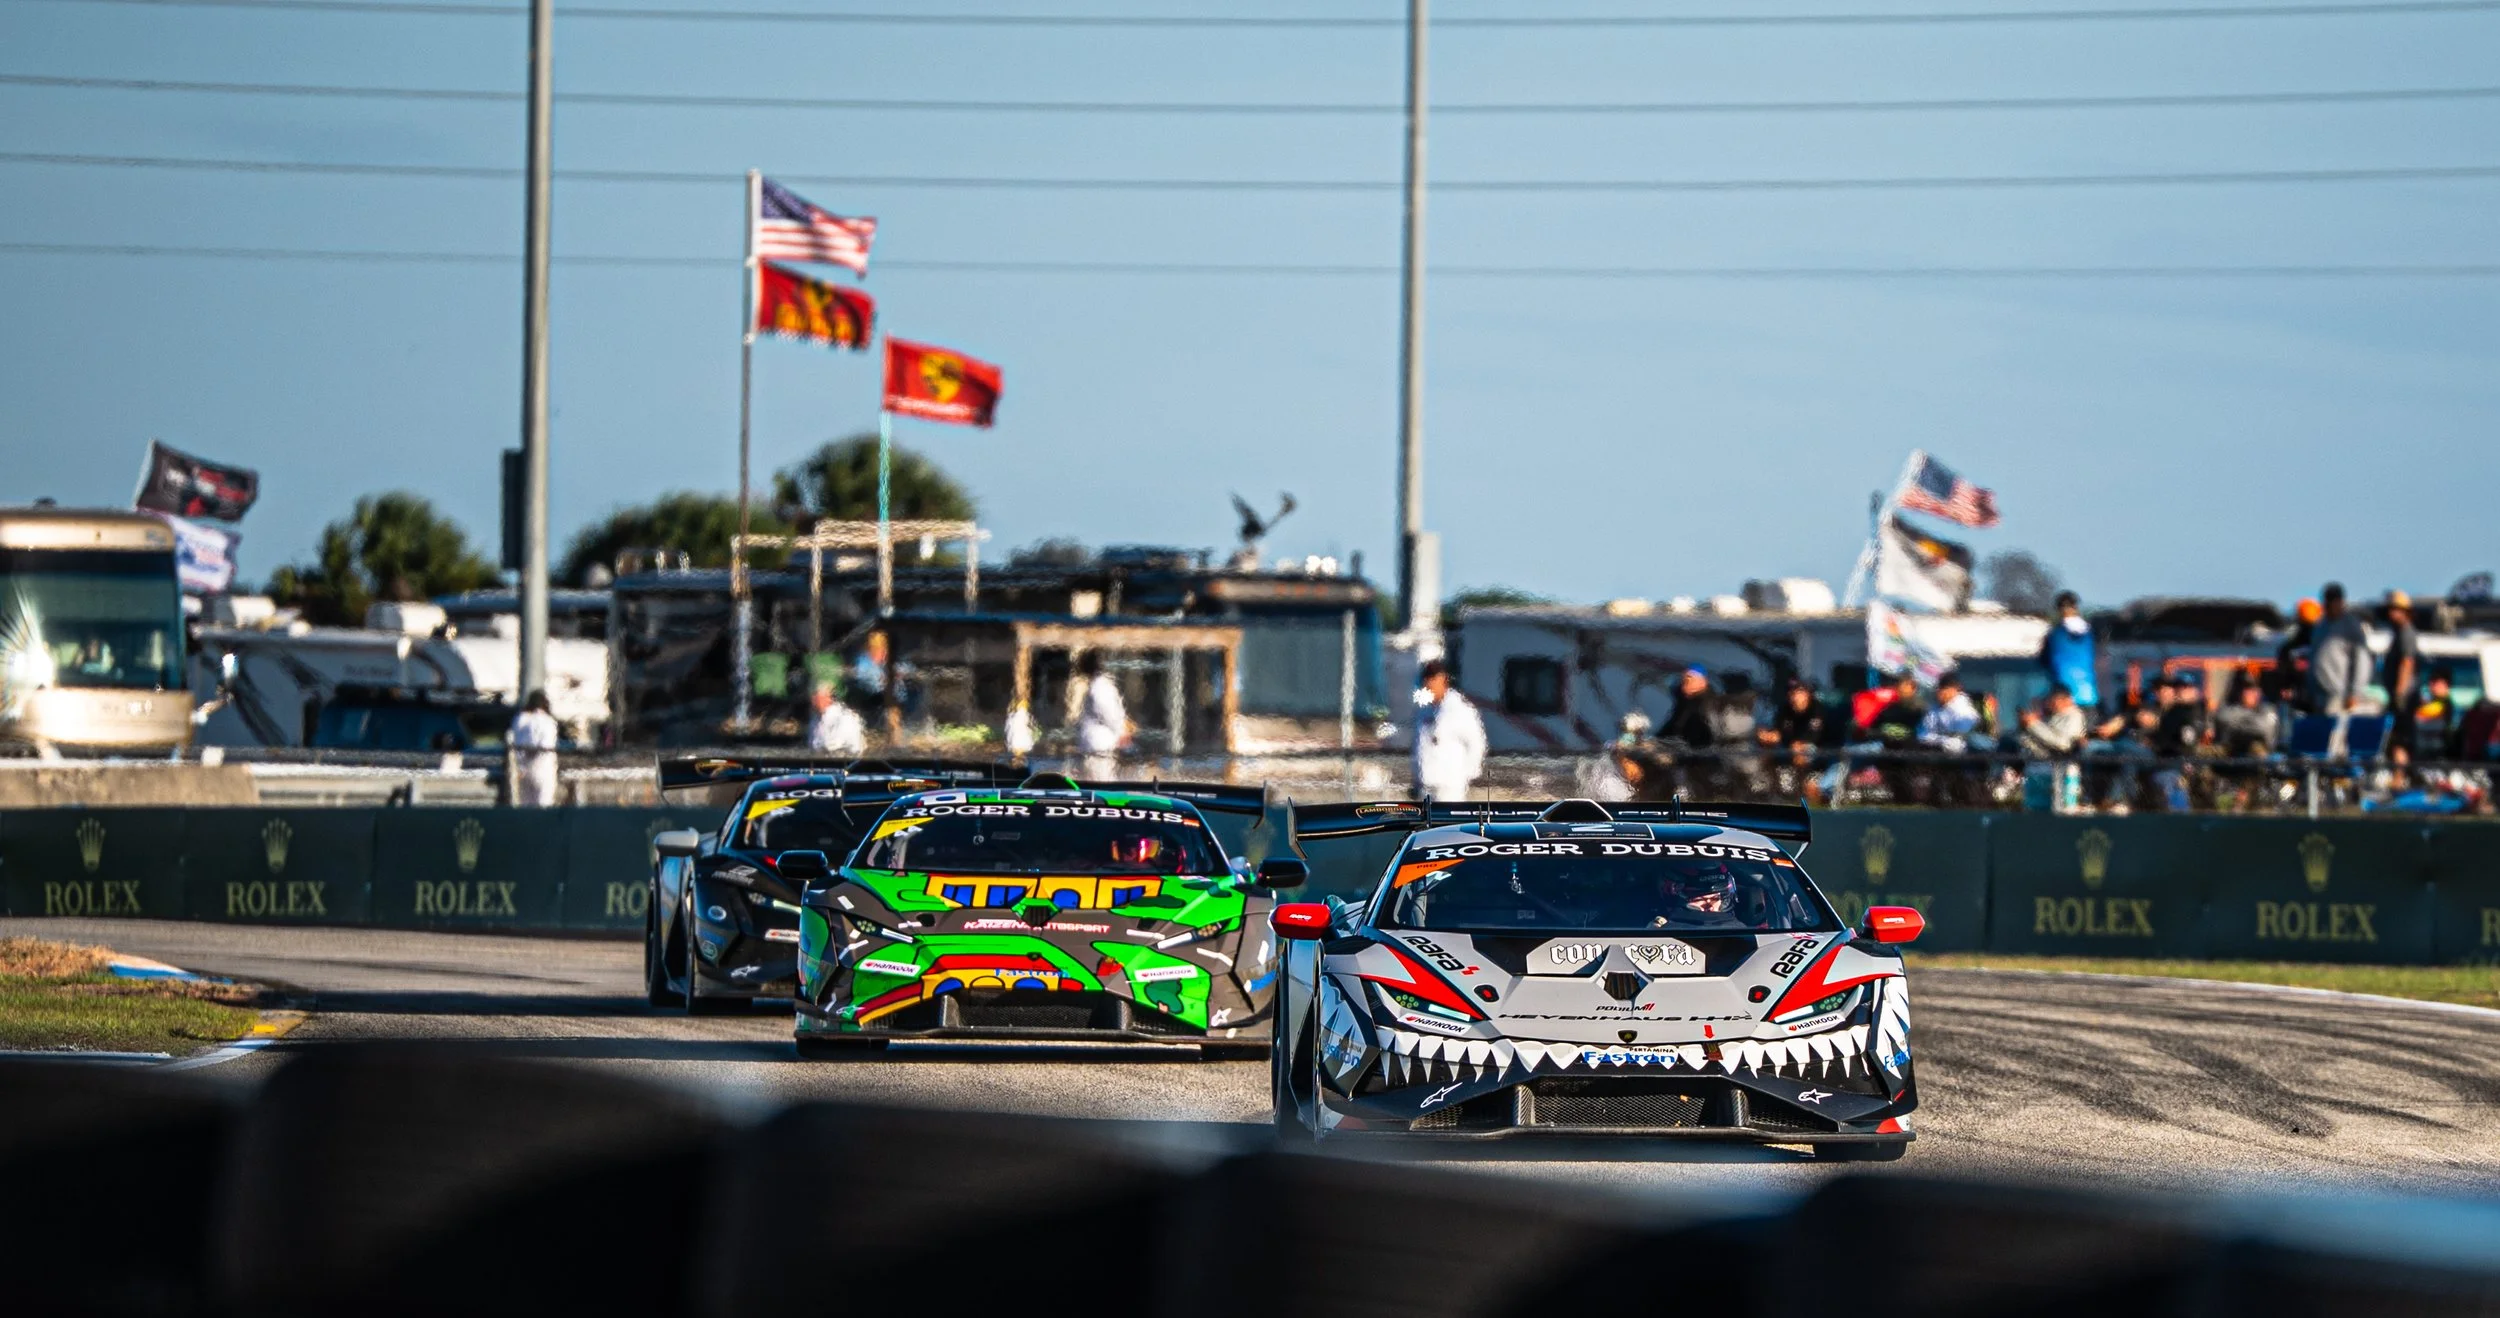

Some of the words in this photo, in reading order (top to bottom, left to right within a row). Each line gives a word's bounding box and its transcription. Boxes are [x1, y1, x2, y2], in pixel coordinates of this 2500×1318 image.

[903, 805, 1031, 818] ROGER
[1046, 806, 1183, 823] DUBUIS
[1426, 843, 1583, 860] ROGER
[1602, 843, 1771, 862] DUBUIS
[45, 880, 141, 915] ROLEX
[226, 881, 326, 916] ROLEX
[415, 881, 516, 916] ROLEX
[2034, 898, 2154, 937] ROLEX
[2256, 903, 2378, 943] ROLEX
[1582, 1050, 1676, 1064] Fastron
[1629, 1046, 1675, 1054] PERTAMINA
